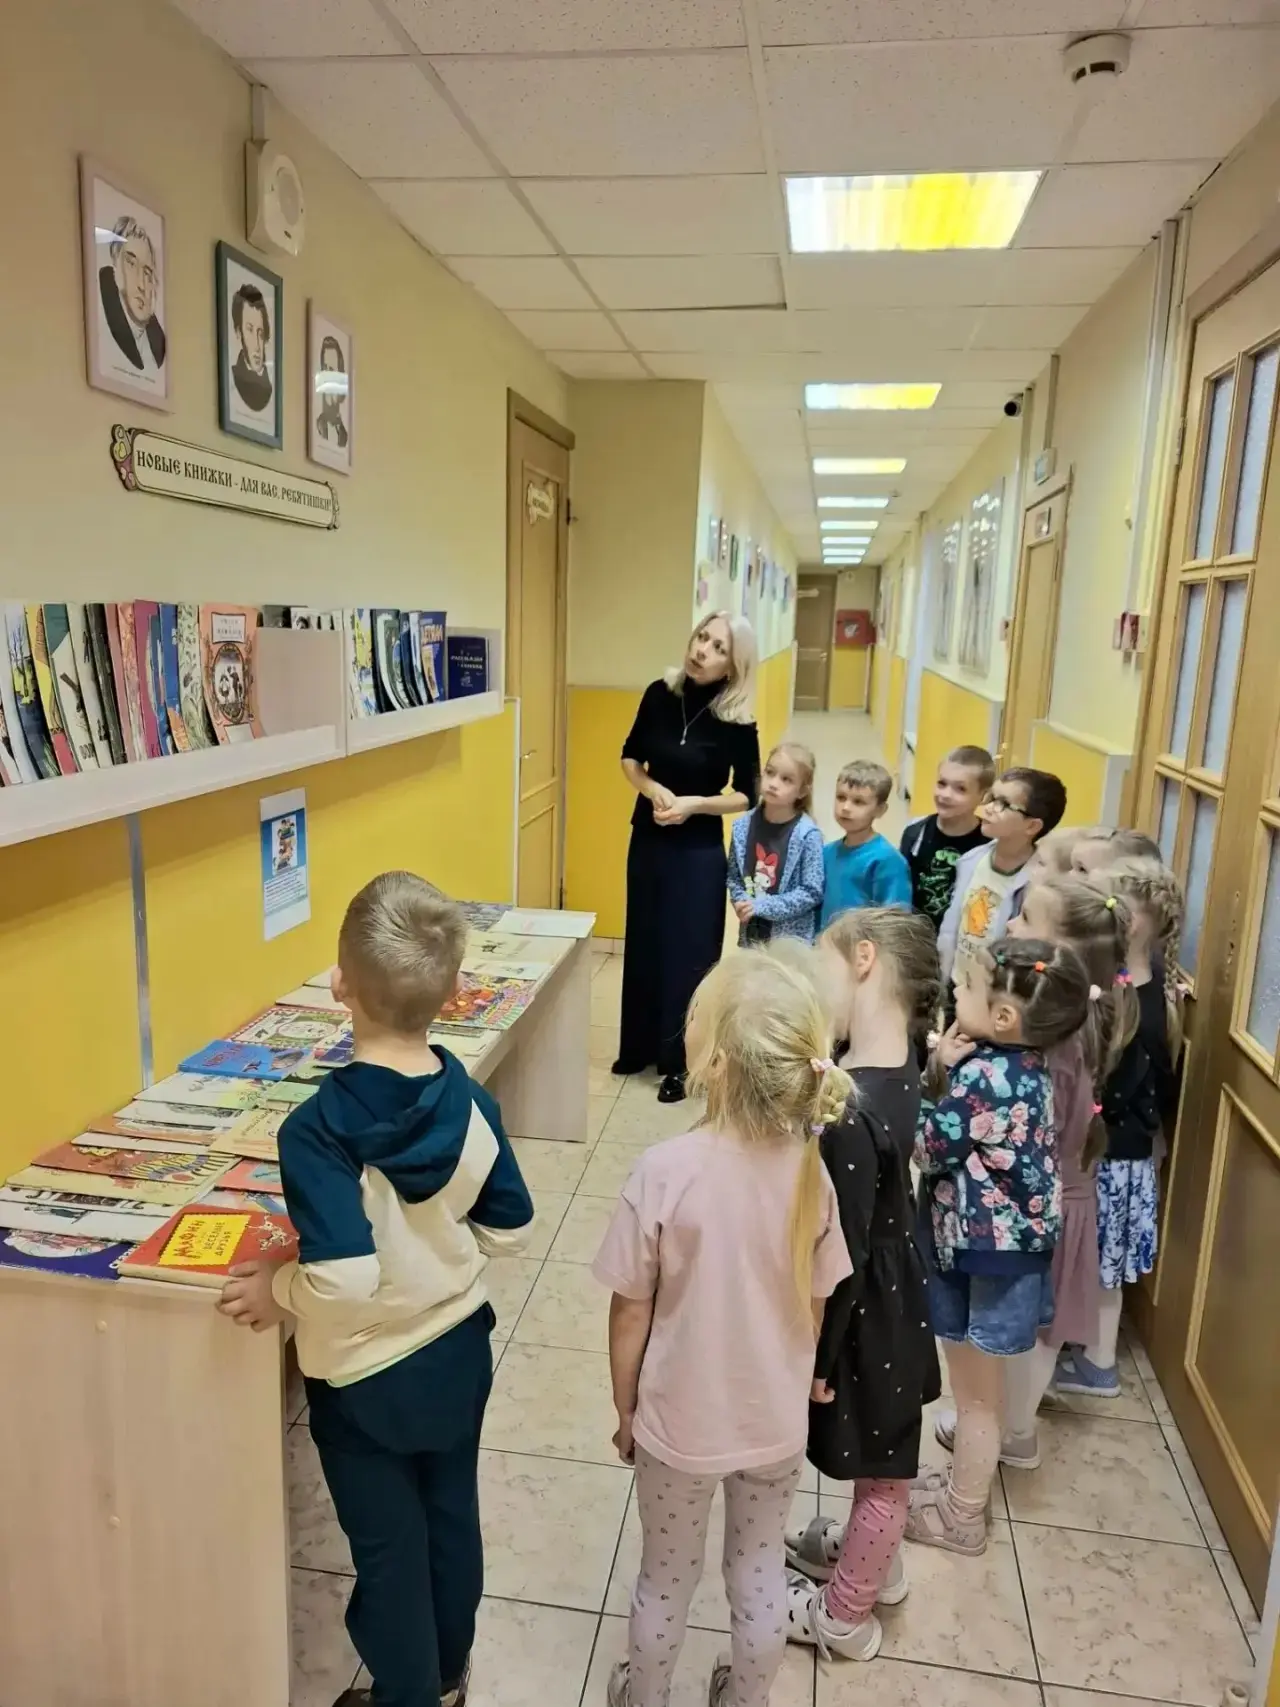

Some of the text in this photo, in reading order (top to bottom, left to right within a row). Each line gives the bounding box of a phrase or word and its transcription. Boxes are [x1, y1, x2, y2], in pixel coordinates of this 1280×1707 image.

[136, 450, 181, 475] НОВЫЕ
[184, 461, 233, 488] КНИЖКИ
[240, 476, 259, 494] ДЛЯ
